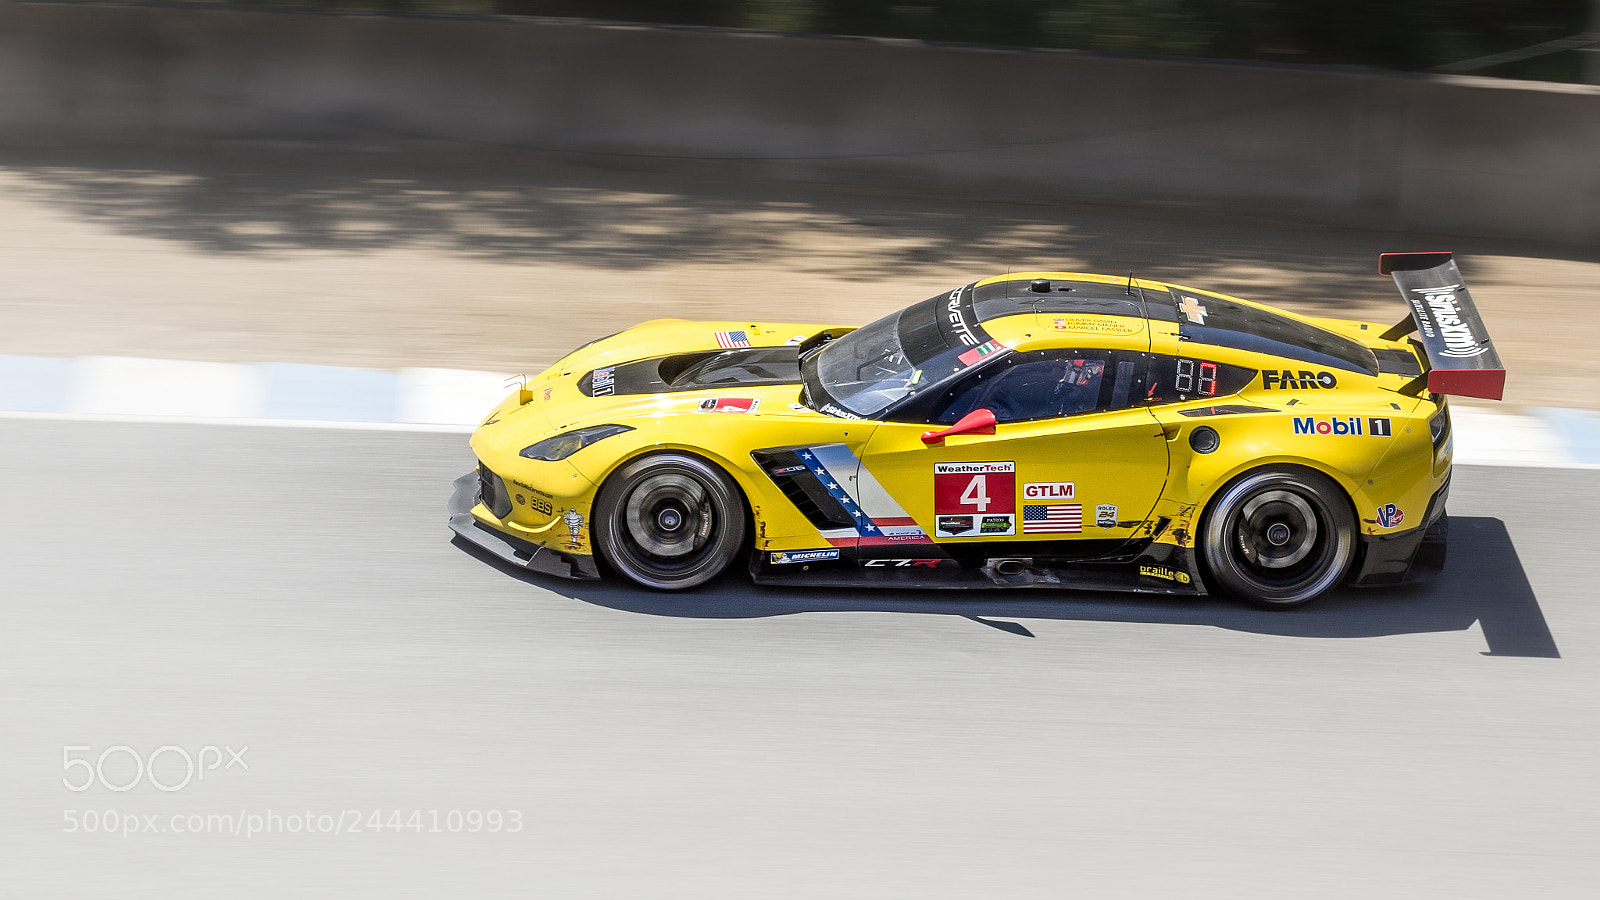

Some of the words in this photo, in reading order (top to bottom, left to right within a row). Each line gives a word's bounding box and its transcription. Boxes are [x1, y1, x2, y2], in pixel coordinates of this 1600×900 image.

[1261, 370, 1337, 390] FARO
[1293, 417, 1362, 435] Mobil
[937, 464, 1011, 473] WeatherTech
[959, 474, 992, 512] 4
[1026, 485, 1073, 497] GTLM
[531, 495, 553, 516] BBS
[1376, 503, 1397, 528] VP
[791, 551, 838, 560] MICHELIN
[1139, 565, 1174, 577] braille
